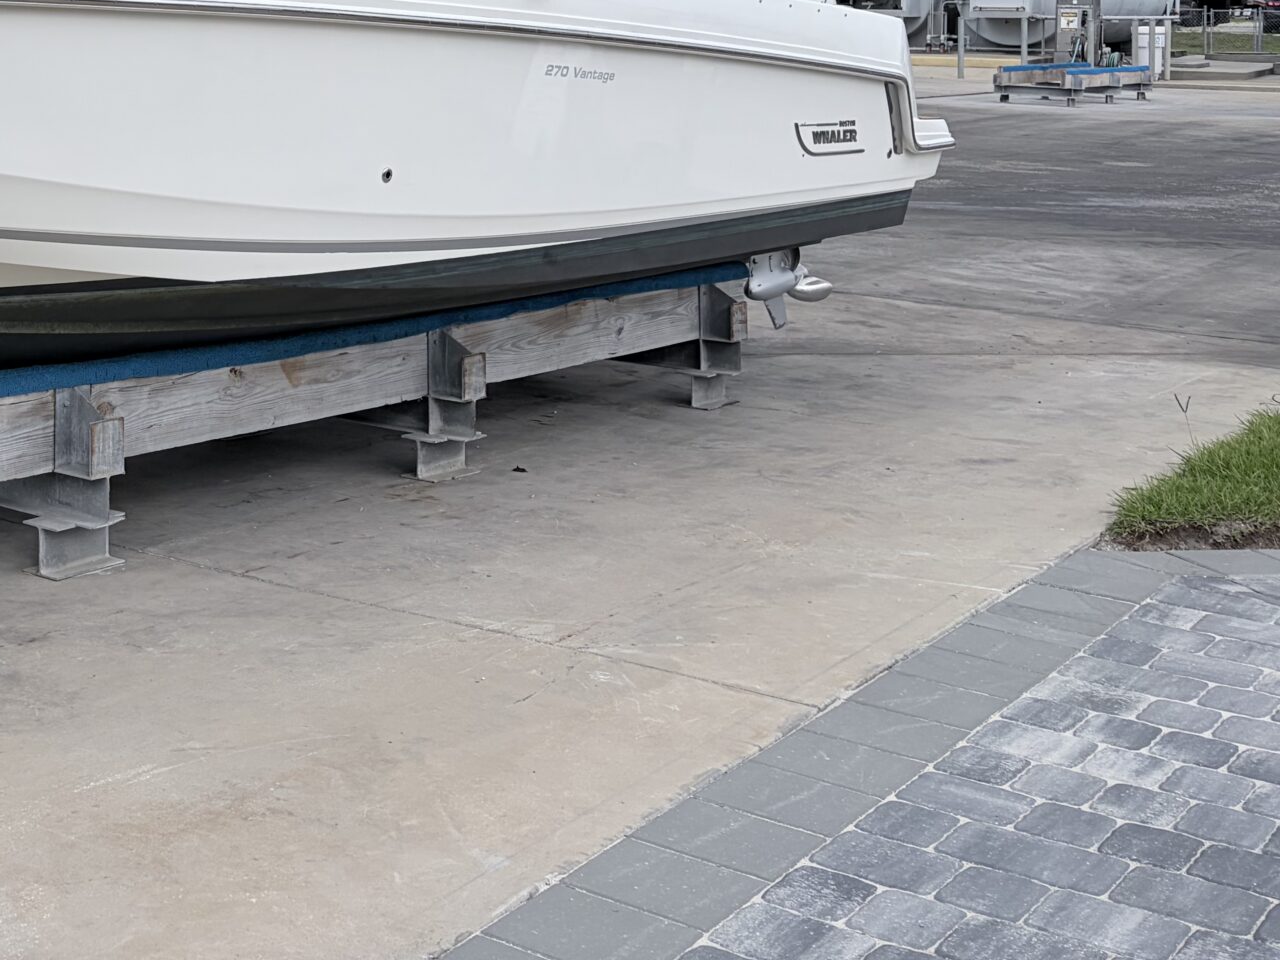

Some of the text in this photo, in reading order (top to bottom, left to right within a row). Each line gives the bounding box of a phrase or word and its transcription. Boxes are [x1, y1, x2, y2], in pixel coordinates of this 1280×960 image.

[545, 64, 615, 84] 270 Vantage
[812, 128, 858, 145] WHALER
